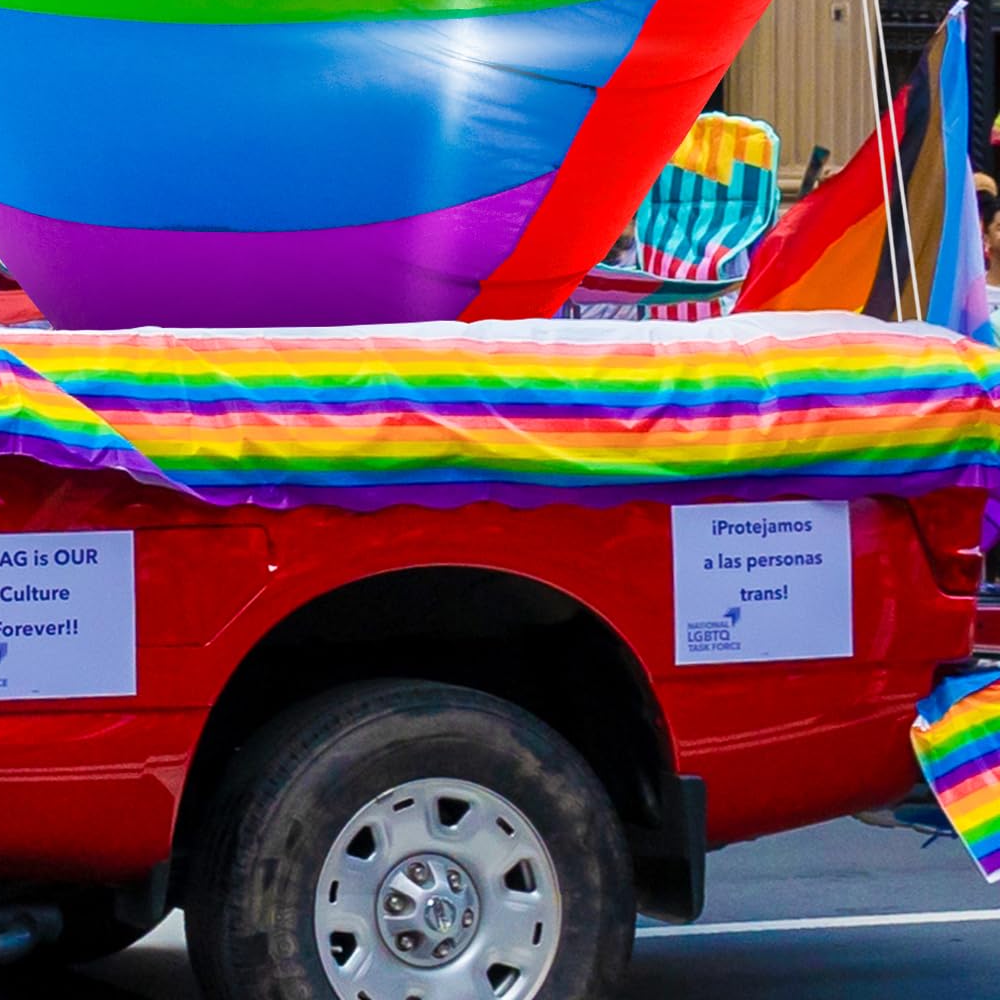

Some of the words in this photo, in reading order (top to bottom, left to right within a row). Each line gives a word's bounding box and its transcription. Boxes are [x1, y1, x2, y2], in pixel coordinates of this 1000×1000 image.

[33, 549, 49, 567] is
[53, 548, 99, 566] OUR
[703, 558, 714, 570] a
[717, 553, 743, 570] las
[746, 552, 823, 573] personas
[0, 584, 71, 602] Culture
[739, 584, 789, 602] trans!
[687, 629, 731, 643] LGBTQ
